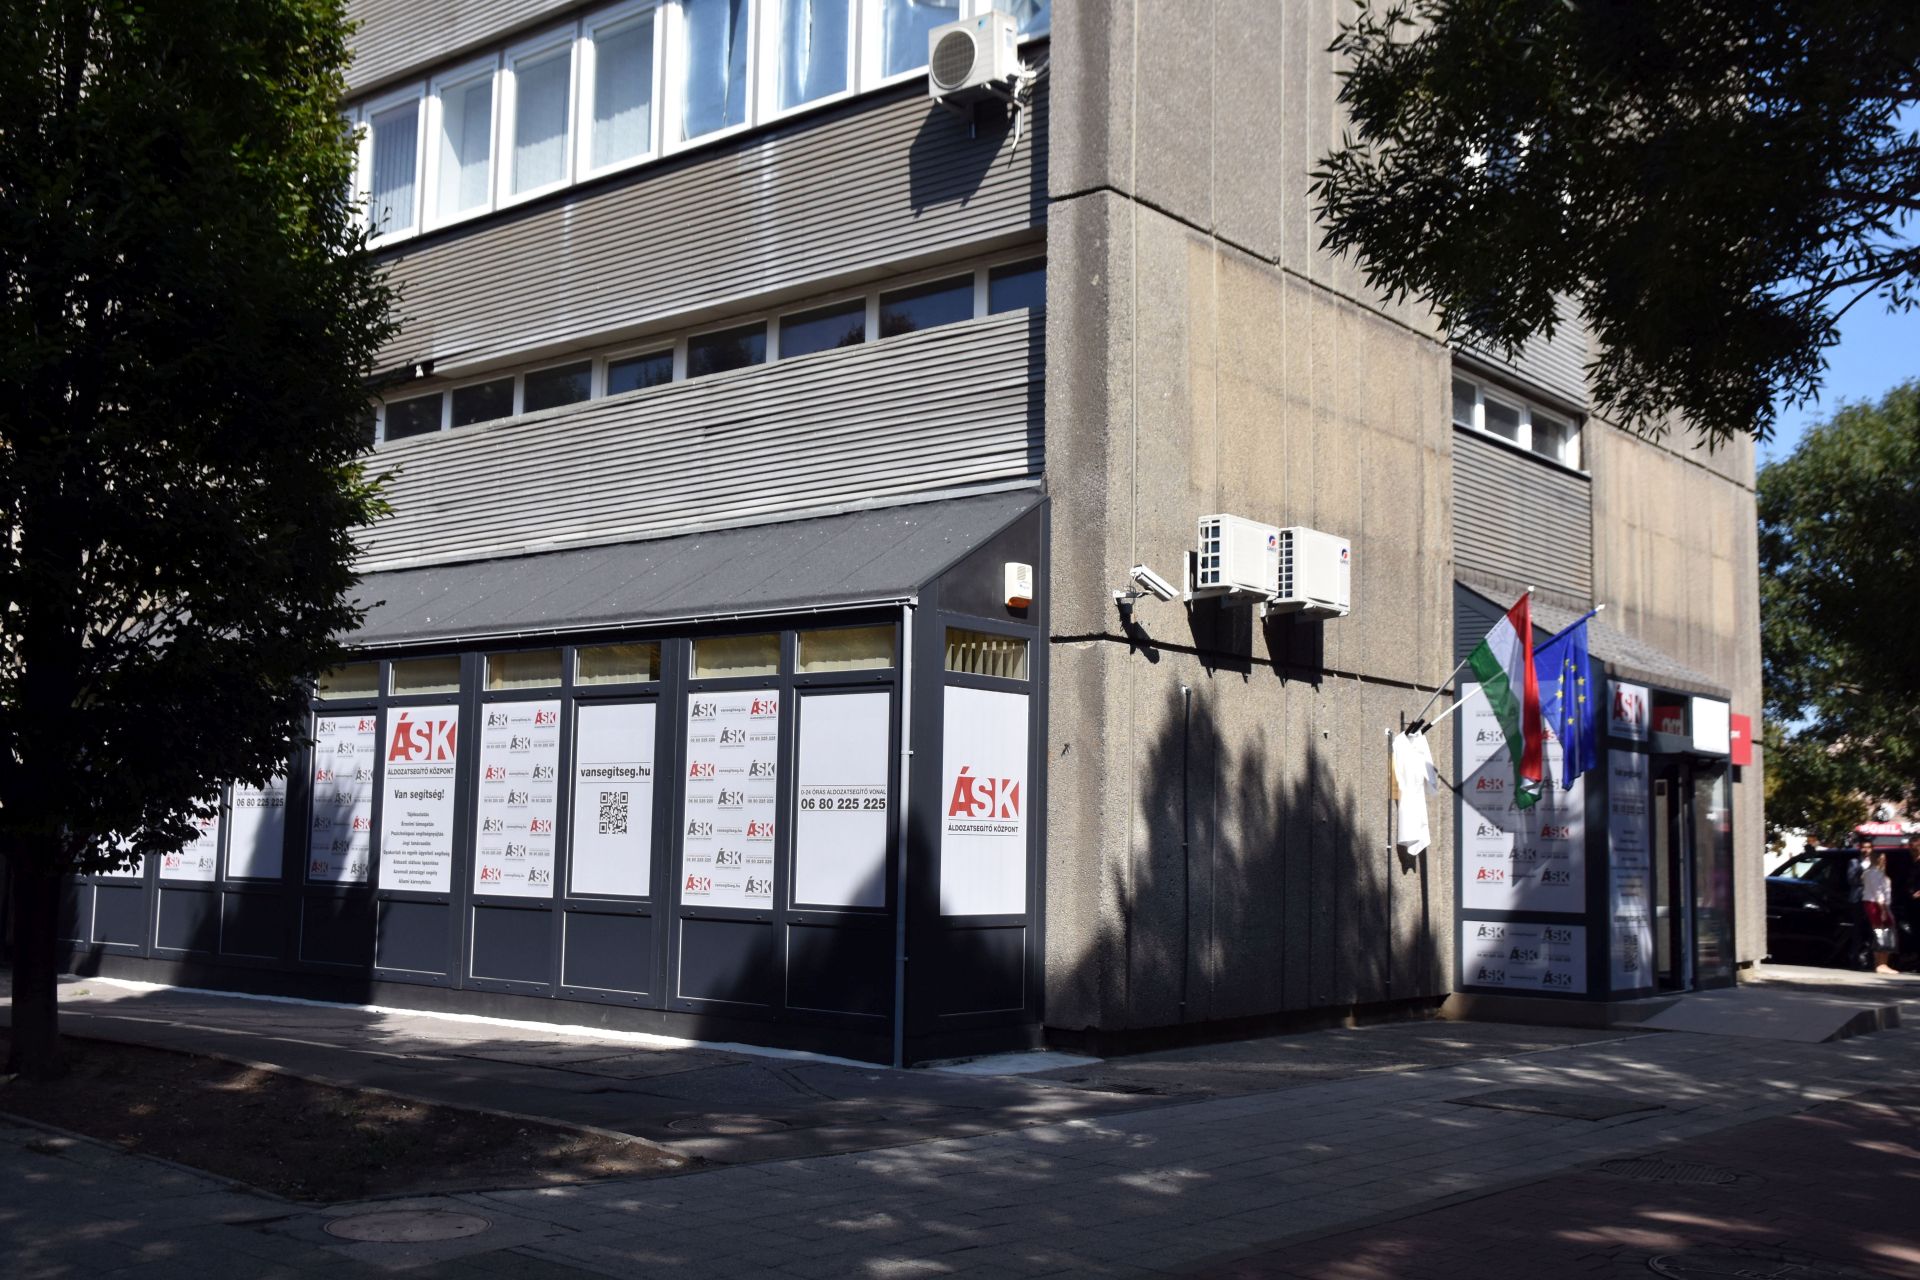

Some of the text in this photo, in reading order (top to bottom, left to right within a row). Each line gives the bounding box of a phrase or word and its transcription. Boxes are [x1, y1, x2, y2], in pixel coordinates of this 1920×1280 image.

[691, 700, 717, 717] ÁSK
[751, 698, 777, 714] ÁSK
[488, 711, 508, 726] ÁSK
[535, 709, 556, 724] ÁSK
[388, 712, 456, 761] ÁSK
[510, 734, 530, 749] ÁSK
[719, 726, 746, 743] ÁSK
[1476, 728, 1504, 742] ÁSK
[388, 767, 454, 775] ÁLDOZATSEGÍTŐ KÖZPONT
[485, 764, 506, 779] ÁSK
[532, 763, 554, 778] ÁSK
[580, 765, 651, 779] vansegitseg.hu
[689, 760, 715, 777] ÁSK
[749, 760, 775, 776] ÁSK
[394, 789, 408, 799] Van
[508, 789, 529, 804] ÁSK
[717, 788, 743, 804] ÁSK
[949, 766, 1019, 818] ÁSK
[801, 798, 886, 809] 06 80 225 225
[483, 816, 503, 831] ÁSK
[530, 817, 551, 832] ÁSK
[687, 819, 713, 835] ÁSK
[747, 819, 773, 836] ÁSK
[948, 823, 1019, 833] ÁLDOZATSEGÍTŐ KÖZPONT
[1477, 822, 1504, 837] ÁSK
[505, 841, 526, 856] ÁSK
[716, 848, 741, 864] ÁSK
[481, 865, 501, 880] ÁSK
[528, 867, 549, 882] ÁSK
[1477, 866, 1504, 880] ÁSK
[685, 873, 711, 890] ÁSK
[745, 875, 772, 893] ÁSK
